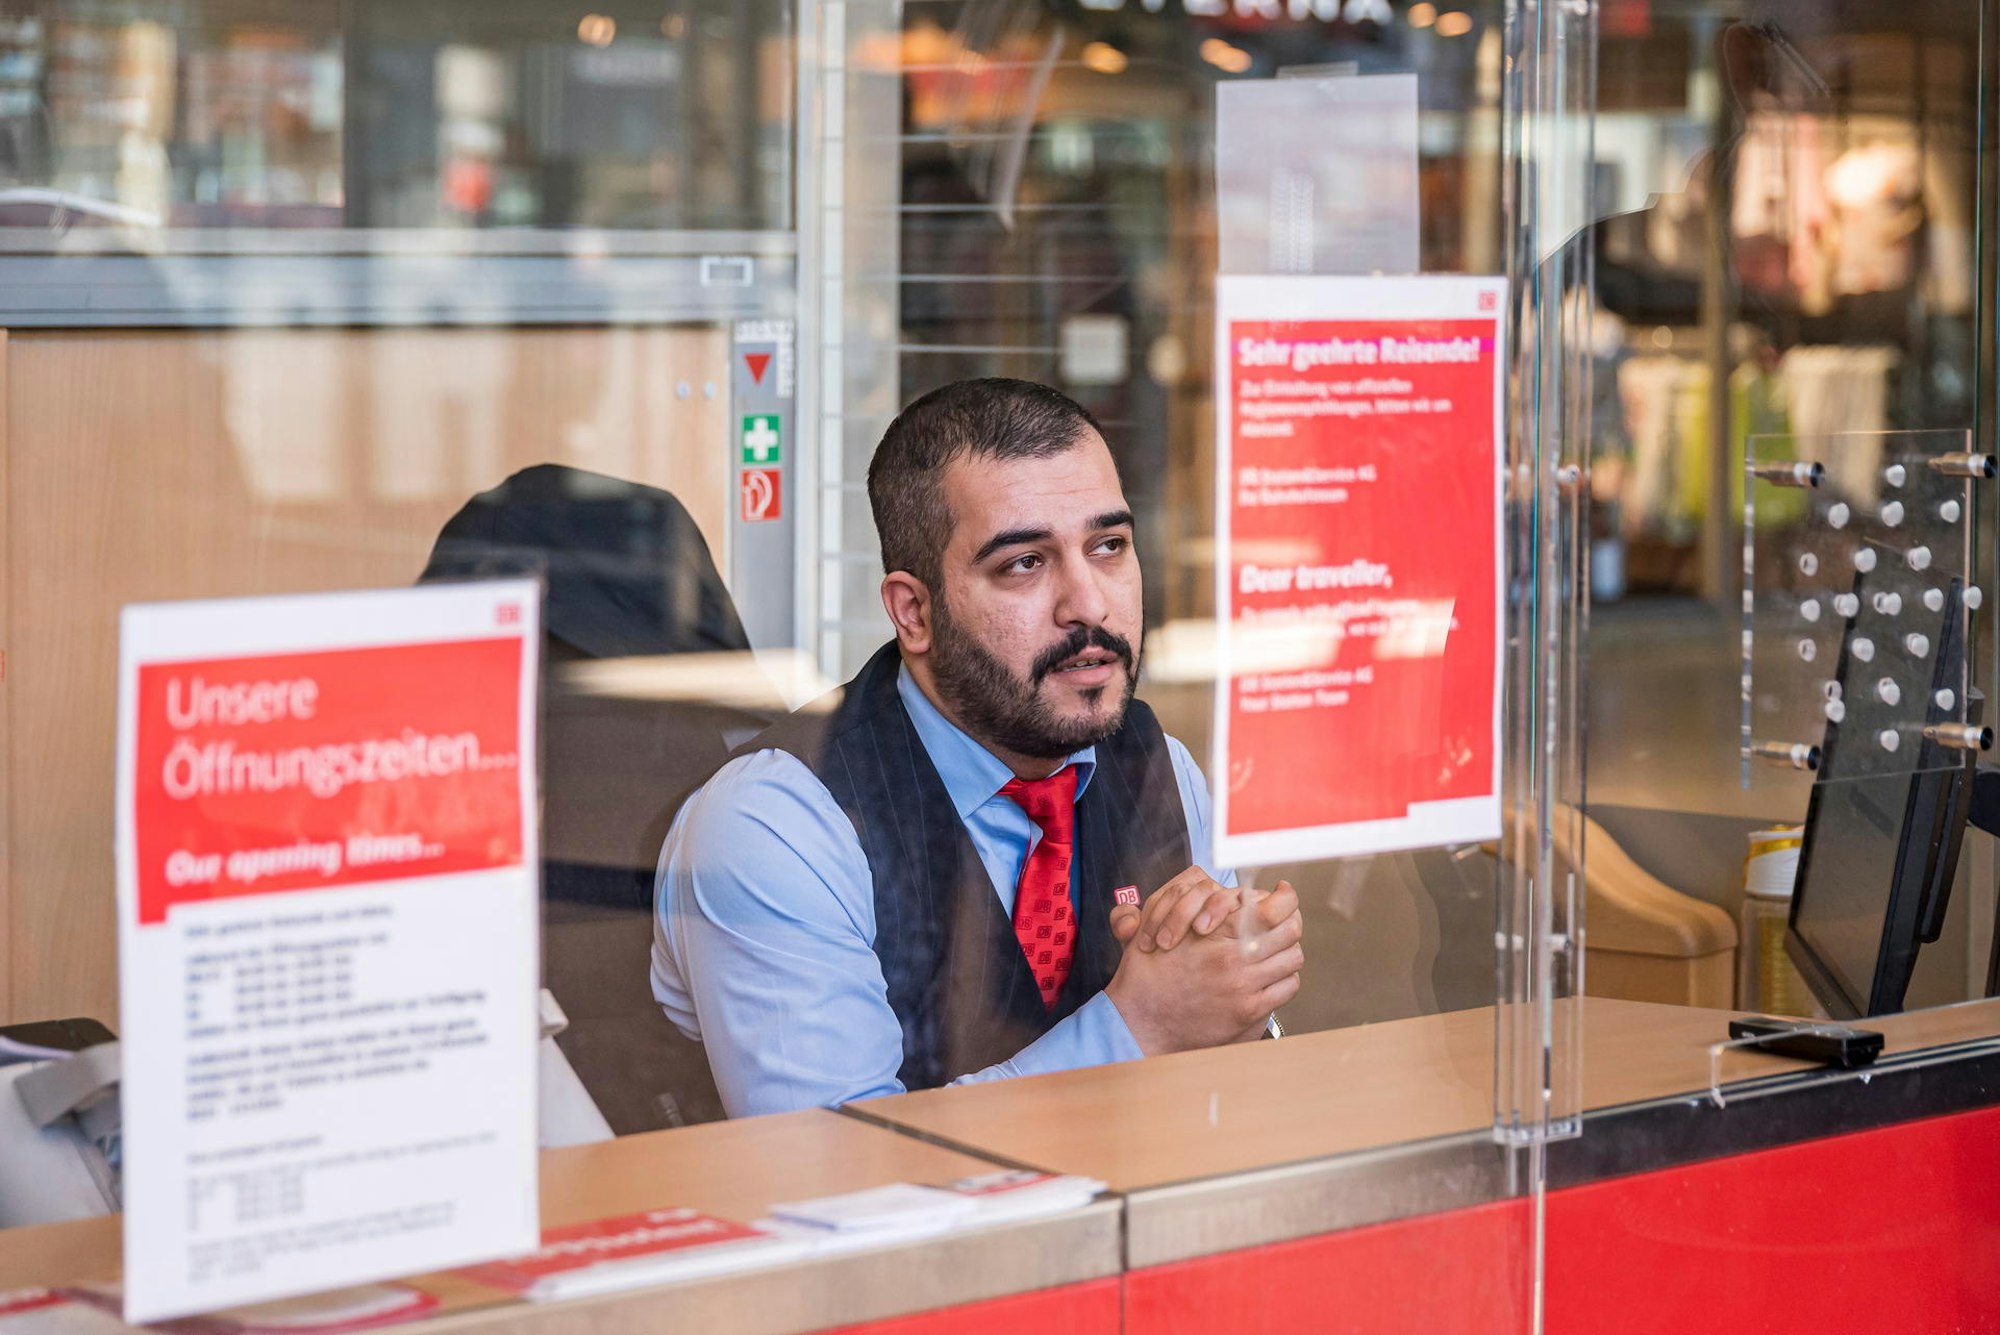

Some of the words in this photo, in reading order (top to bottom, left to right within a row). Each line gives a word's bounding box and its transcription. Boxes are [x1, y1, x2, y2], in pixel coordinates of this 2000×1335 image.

[1239, 338, 1290, 365] Sehr
[1292, 339, 1377, 371] geehrte
[1380, 336, 1479, 364] Reisende!
[1239, 564, 1293, 593] Dear
[1296, 559, 1392, 590] traveller,
[166, 677, 318, 729] Unsere
[163, 727, 518, 800] Öffnungszeiten...
[166, 849, 219, 886] Our
[226, 837, 341, 881] opening
[1118, 888, 1138, 905] DB
